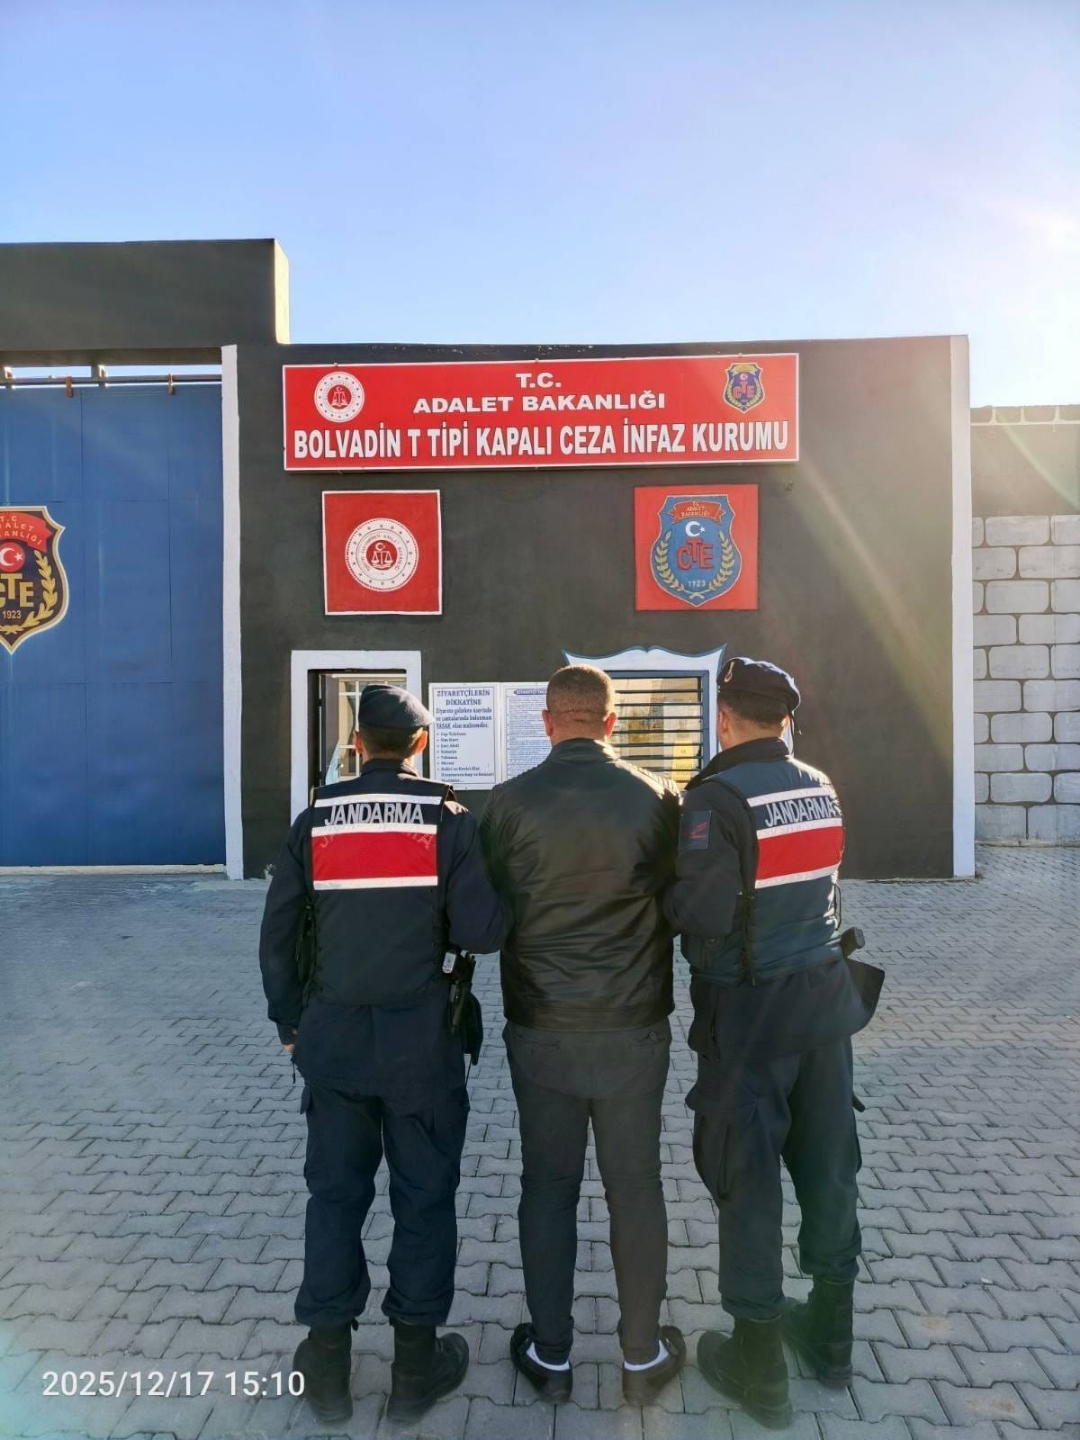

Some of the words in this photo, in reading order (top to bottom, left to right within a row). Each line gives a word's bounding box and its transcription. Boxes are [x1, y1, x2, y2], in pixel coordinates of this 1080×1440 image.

[515, 372, 562, 389] T.C.
[413, 396, 514, 414] ADALET
[522, 389, 665, 412] BAKANLIĞI
[294, 422, 401, 459] BOLVADİN
[407, 428, 421, 457] T
[427, 420, 469, 457] TİPİ
[476, 426, 552, 456] KAPALI
[559, 425, 617, 455] CEZA
[623, 417, 686, 454] İNFAZ
[692, 420, 790, 452] KURUMU
[2, 610, 21, 619] 1923
[325, 802, 424, 826] JANDARMA
[765, 796, 836, 827] JANDARMA
